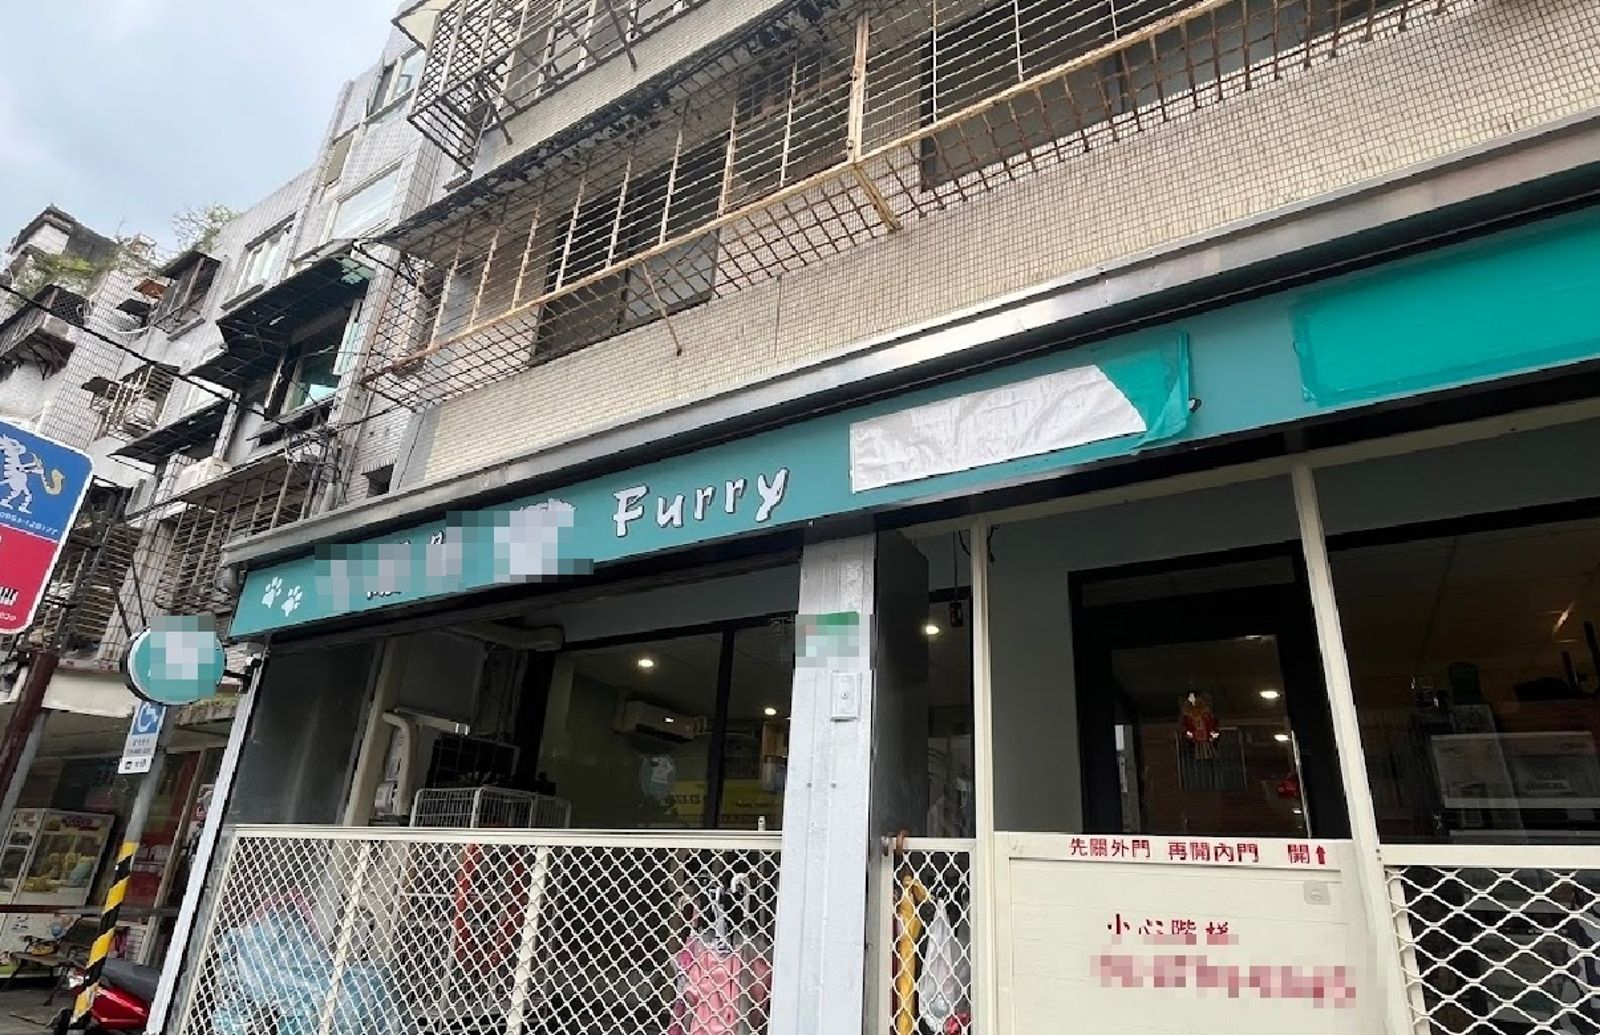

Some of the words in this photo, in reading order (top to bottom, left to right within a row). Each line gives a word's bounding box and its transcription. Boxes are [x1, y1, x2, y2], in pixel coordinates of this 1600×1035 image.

[613, 467, 790, 537] Furry
[1070, 837, 1151, 858] 先關外門
[1168, 841, 1260, 864] 再開內門
[1287, 843, 1310, 864] 開
